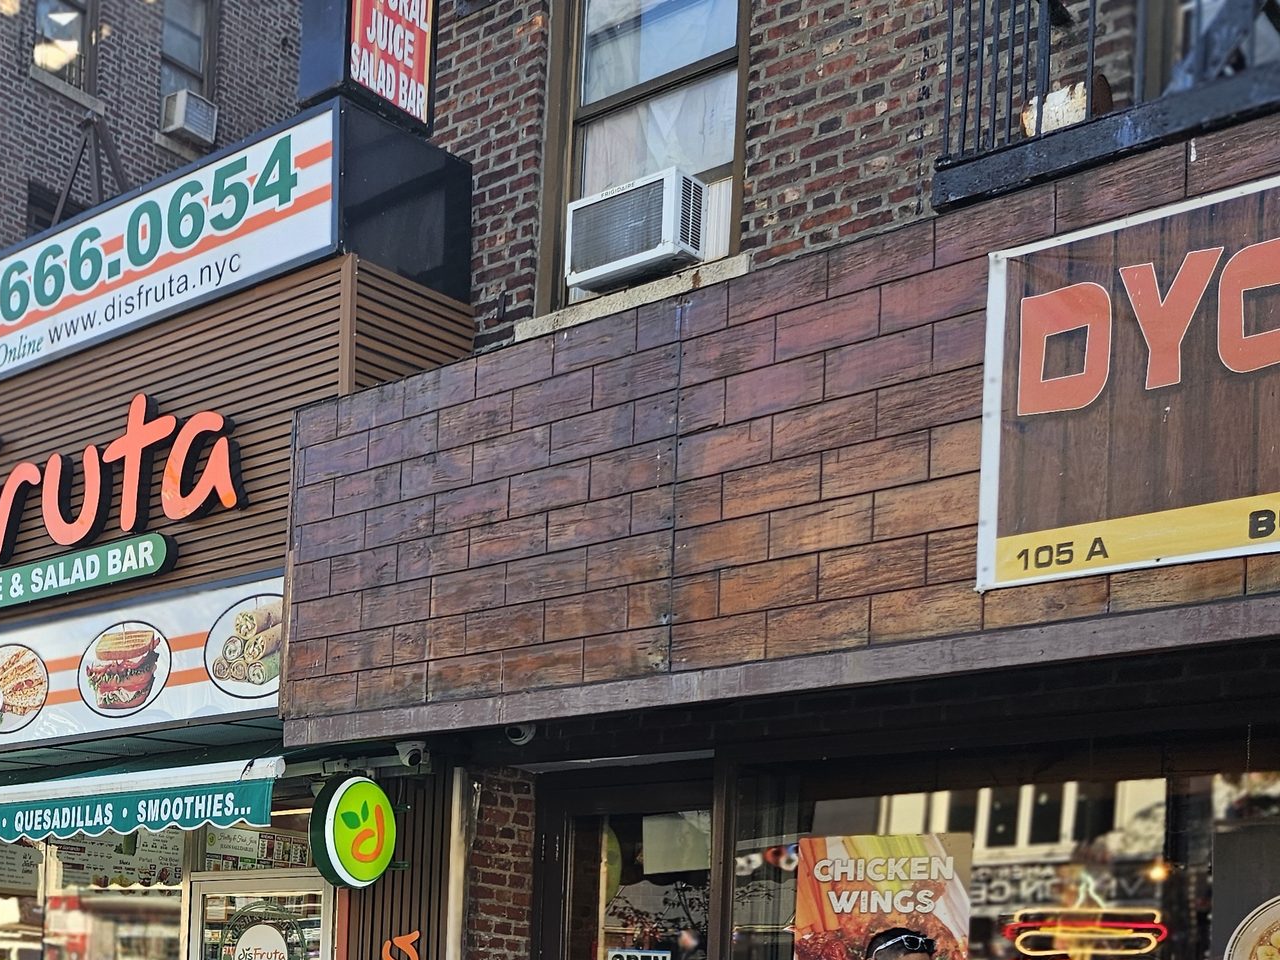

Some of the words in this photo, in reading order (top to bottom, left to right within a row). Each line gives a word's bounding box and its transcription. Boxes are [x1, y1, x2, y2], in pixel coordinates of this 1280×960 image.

[367, 8, 414, 68] JUICE
[350, 42, 396, 100] SALAD
[398, 71, 426, 120] BAR
[48, 251, 242, 346] www.disfruta.nyc
[9, 573, 24, 598] &
[31, 556, 100, 592] SALAD
[107, 540, 155, 576] BAR
[1016, 541, 1074, 571] 105
[1085, 537, 1109, 562] A
[14, 803, 113, 832] QUESADILLAS
[136, 792, 251, 823] SMOOTHIES...
[813, 856, 954, 883] CHICKEN
[827, 889, 936, 914] WINGS
[238, 947, 286, 960] disFruta
